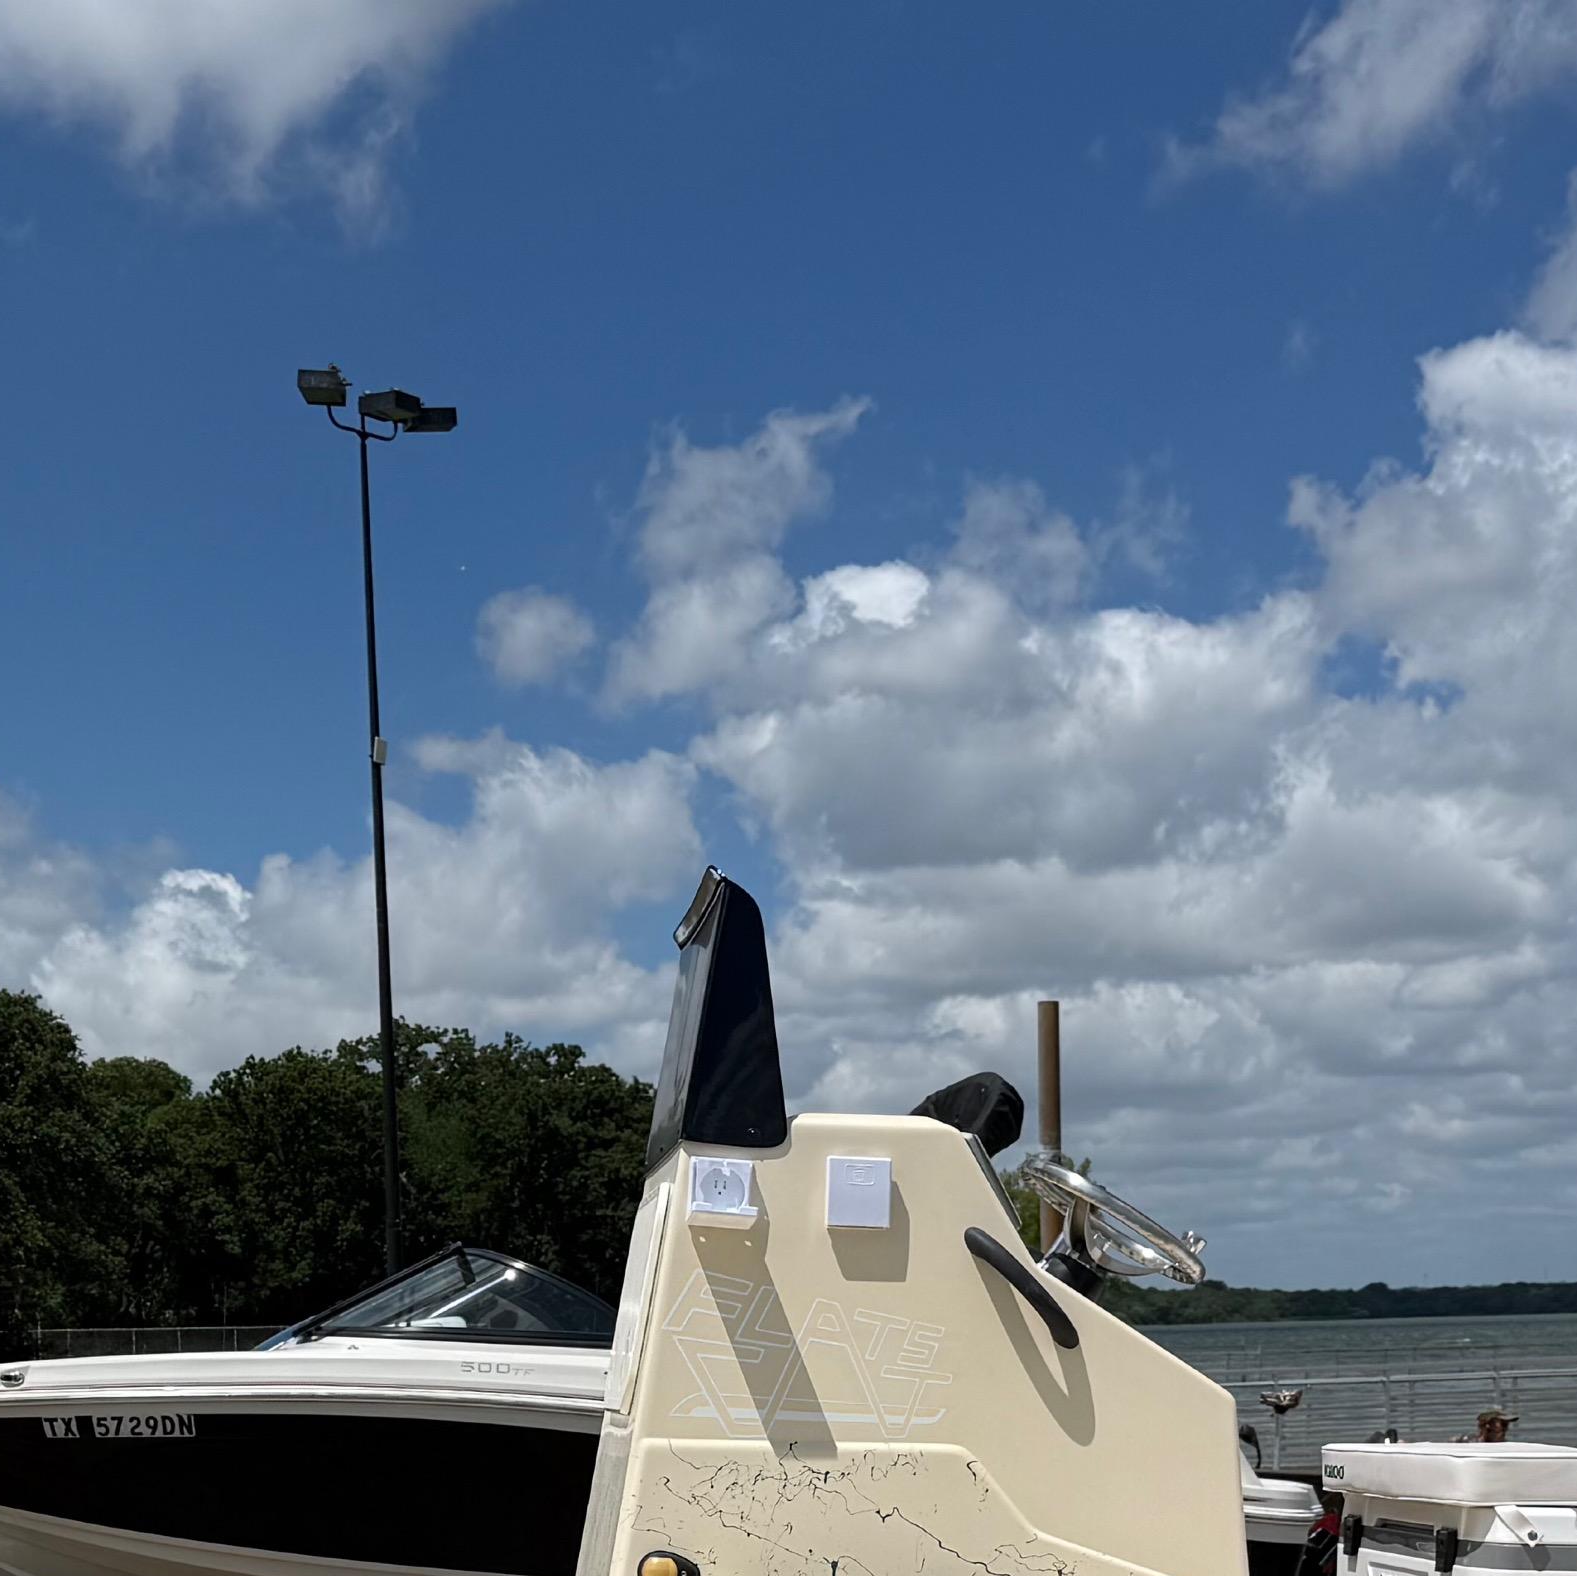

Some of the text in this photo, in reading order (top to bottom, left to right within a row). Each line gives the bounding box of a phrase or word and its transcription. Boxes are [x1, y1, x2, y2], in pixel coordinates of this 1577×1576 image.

[661, 1268, 946, 1369] FLATS
[43, 1413, 195, 1438] TX 5729DN
